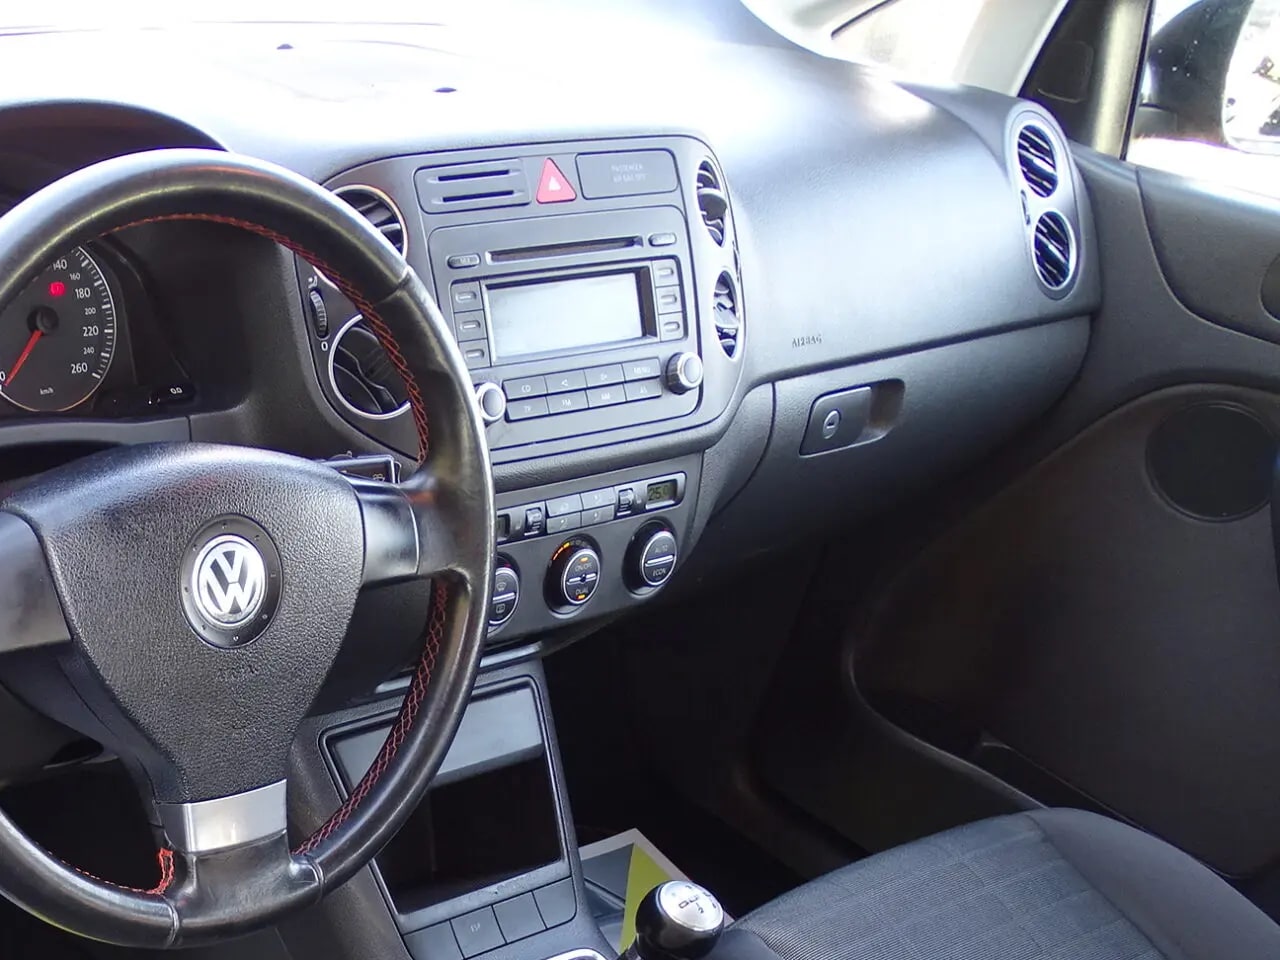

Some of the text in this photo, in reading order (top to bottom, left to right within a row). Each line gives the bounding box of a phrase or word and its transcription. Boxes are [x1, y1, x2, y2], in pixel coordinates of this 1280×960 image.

[75, 287, 91, 299] 180
[84, 307, 96, 316] 200
[82, 325, 99, 337] 220
[83, 346, 95, 355] 240
[70, 362, 88, 374] 260
[521, 384, 531, 393] CD
